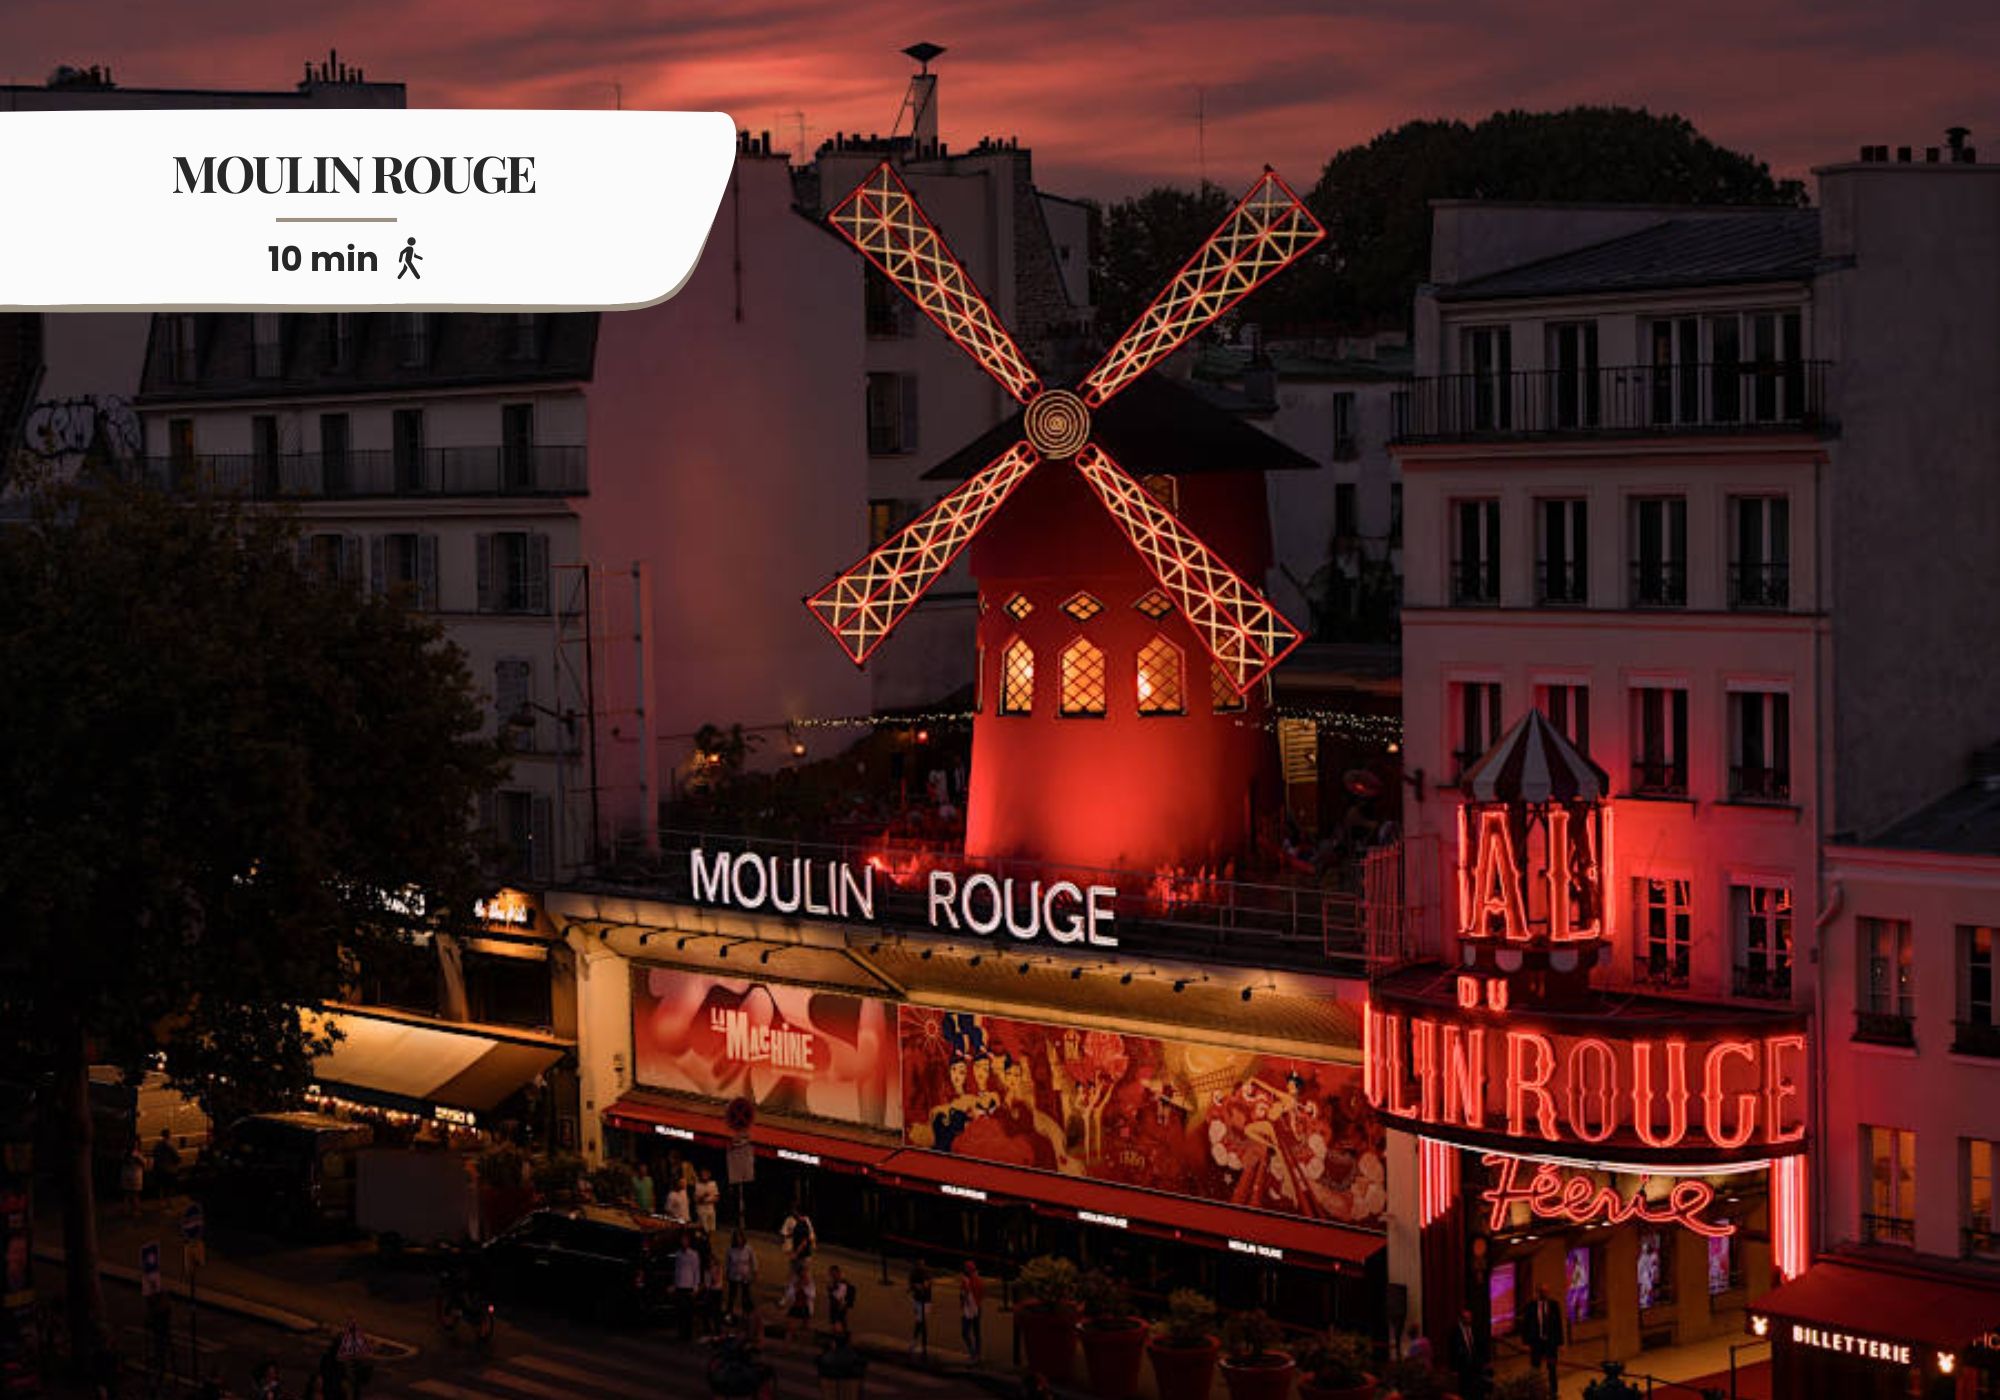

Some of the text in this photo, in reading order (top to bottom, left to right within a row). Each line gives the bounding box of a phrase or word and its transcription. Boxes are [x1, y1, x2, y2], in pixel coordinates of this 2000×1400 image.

[689, 847, 1120, 947] MOULIN ROUGE
[1457, 976, 1510, 1012] DU
[1506, 1031, 1806, 1150] ROUGE
[1481, 1153, 1737, 1237] Féerie
[1791, 1324, 1912, 1364] BILLETTERIE
